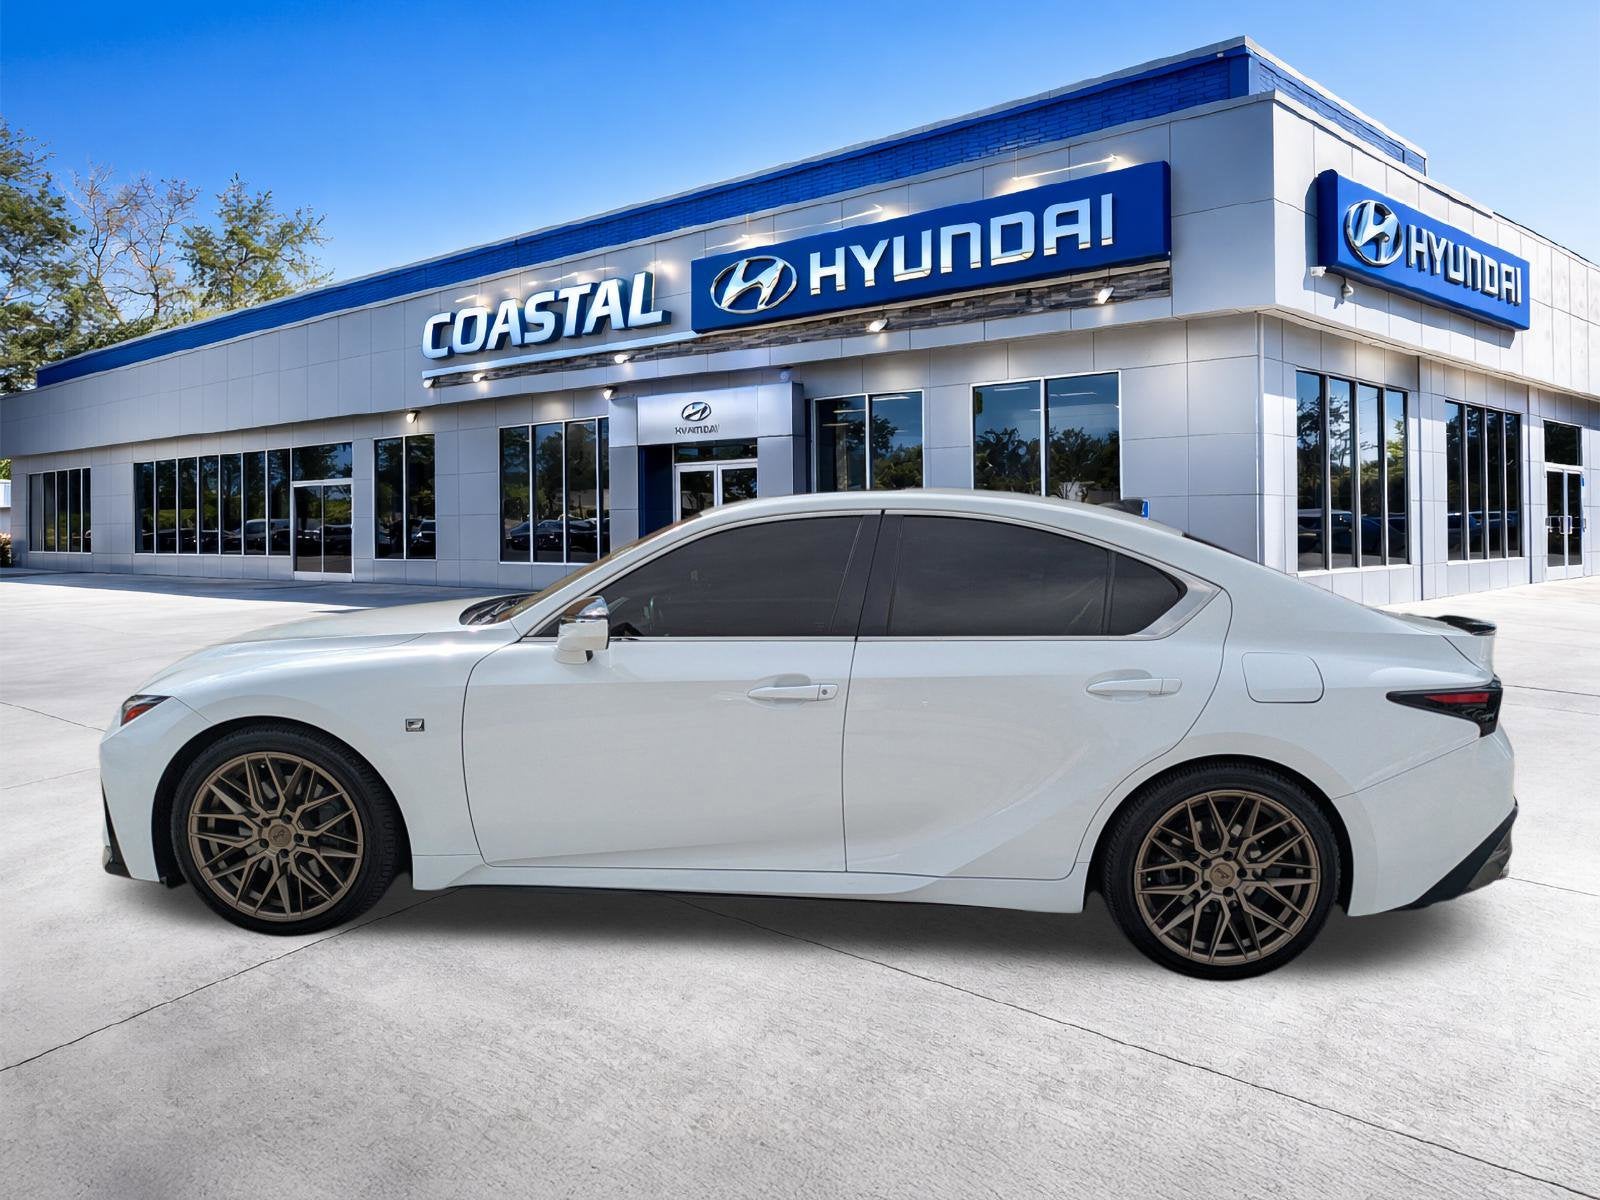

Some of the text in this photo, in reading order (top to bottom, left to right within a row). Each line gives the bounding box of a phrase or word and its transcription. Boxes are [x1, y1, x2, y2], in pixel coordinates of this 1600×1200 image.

[809, 192, 1115, 296] HYUNDAI
[1407, 224, 1522, 306] HYUNDAI
[422, 271, 671, 359] COASTAL
